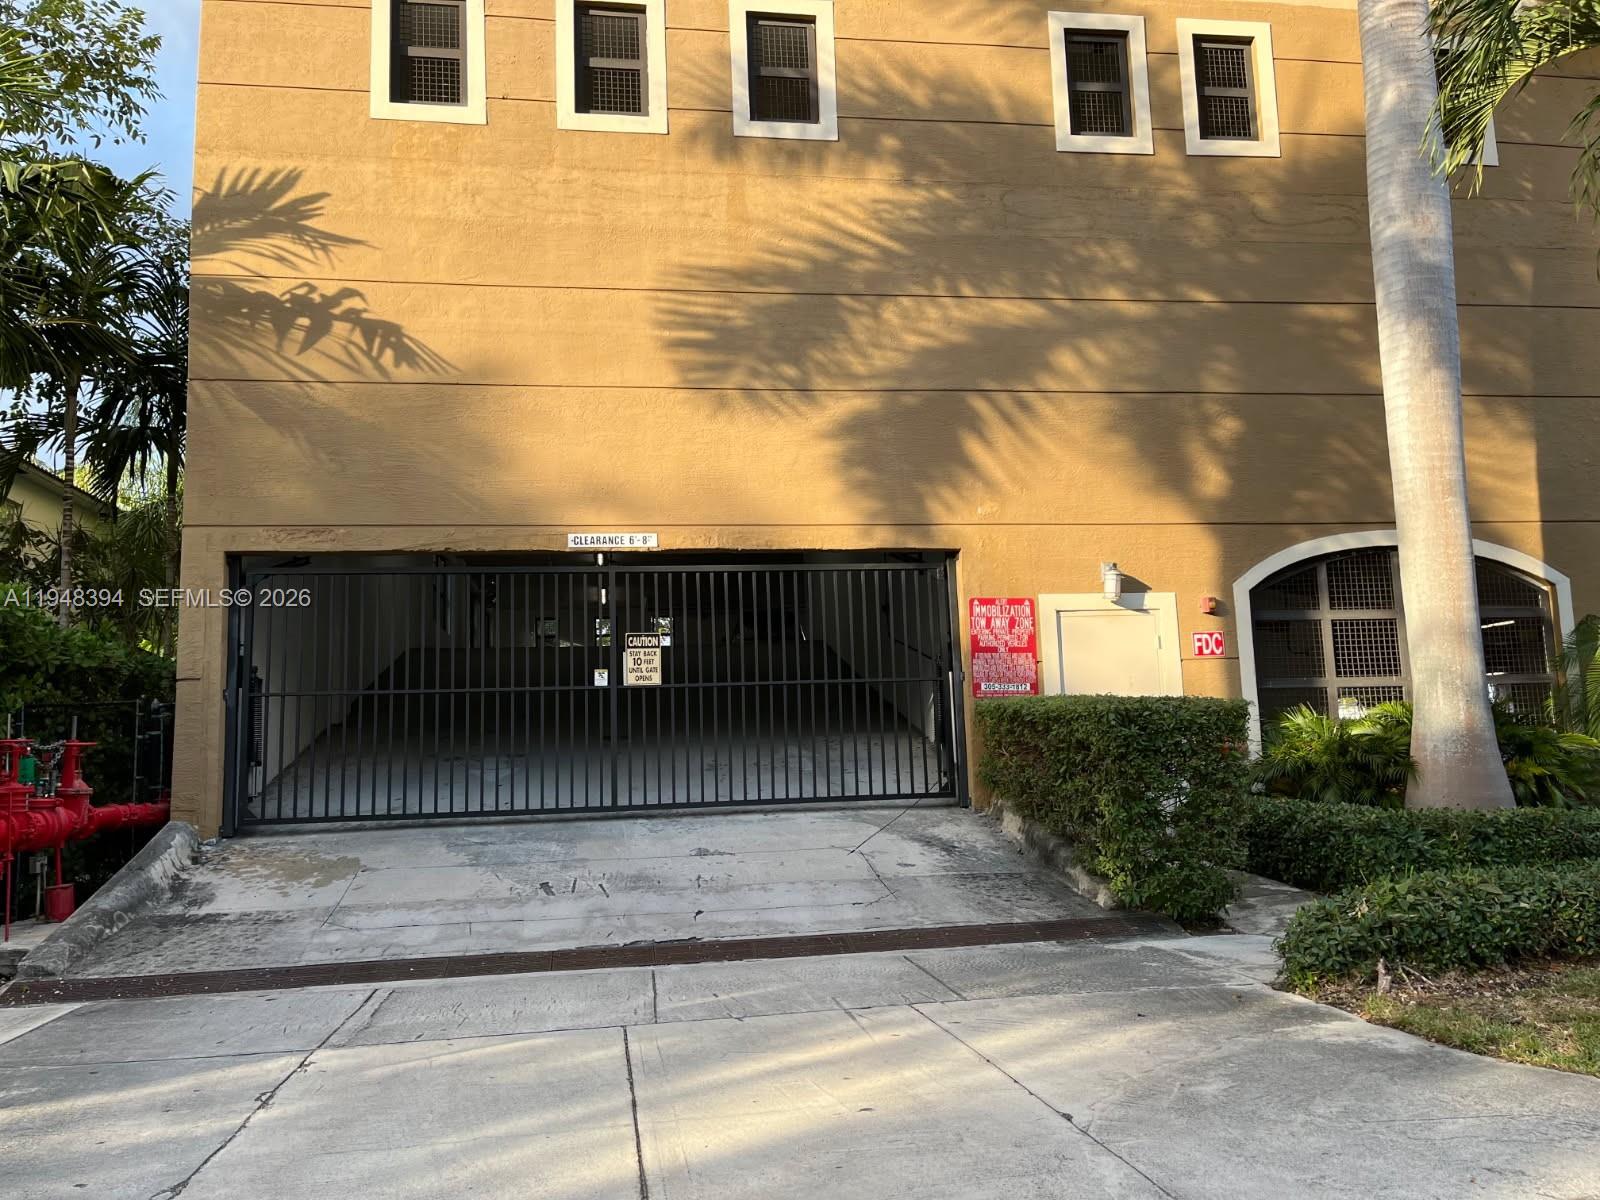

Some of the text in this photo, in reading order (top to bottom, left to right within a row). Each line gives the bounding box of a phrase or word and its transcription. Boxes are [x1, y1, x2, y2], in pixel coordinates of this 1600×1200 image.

[573, 535, 625, 545] CLEARANCE
[973, 605, 1031, 617] IMMOBILIZATION
[971, 617, 1033, 629] TOW AWAY ZONE
[628, 636, 659, 647] CAUTION
[1194, 633, 1223, 655] FDC
[632, 657, 643, 666] 10
